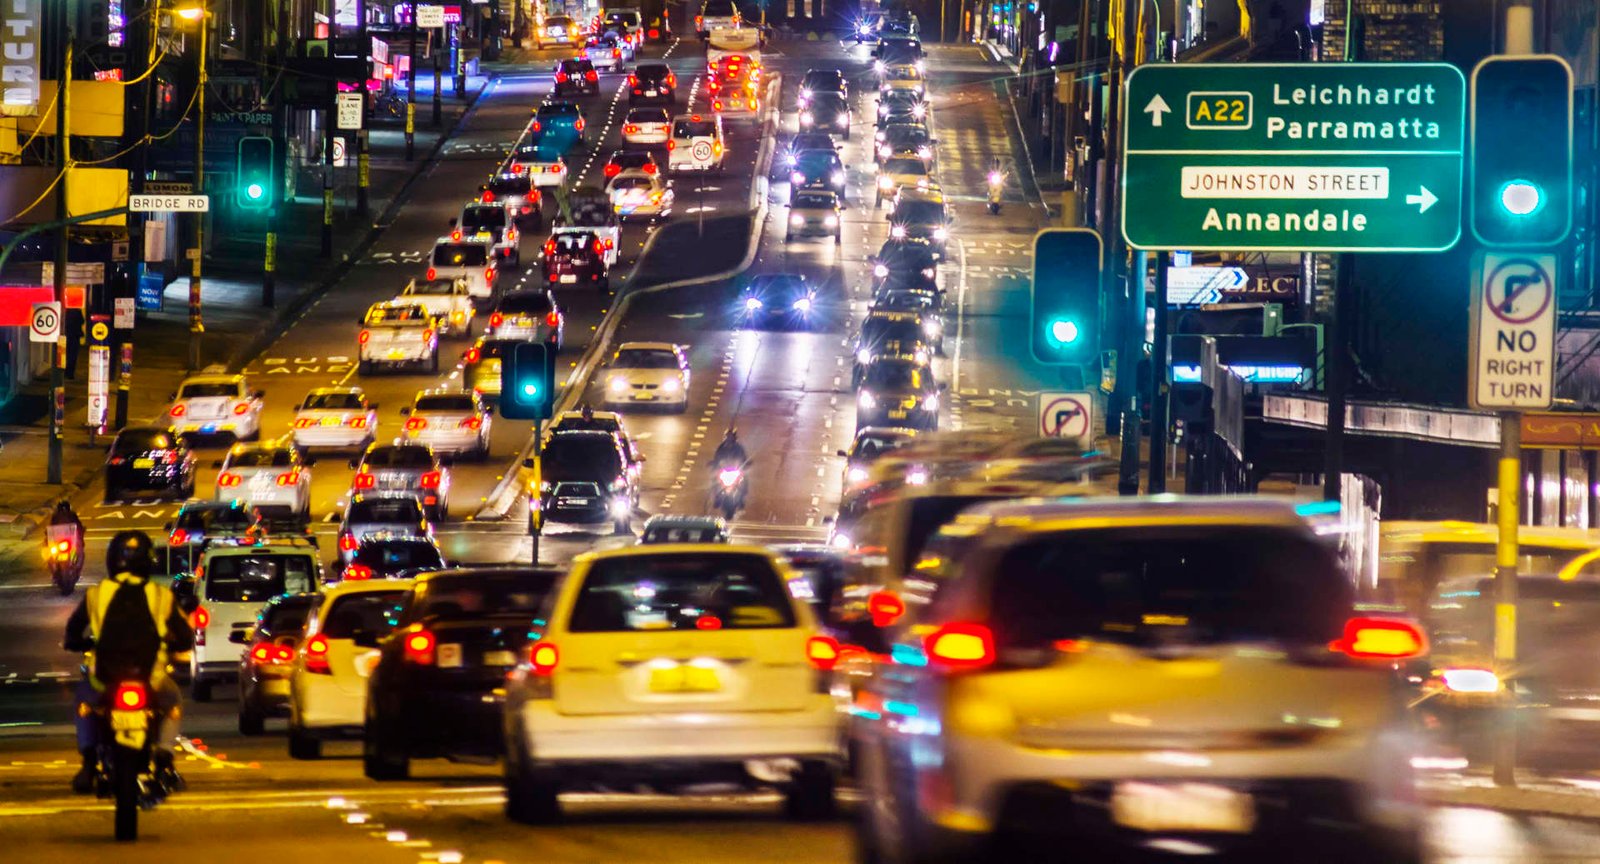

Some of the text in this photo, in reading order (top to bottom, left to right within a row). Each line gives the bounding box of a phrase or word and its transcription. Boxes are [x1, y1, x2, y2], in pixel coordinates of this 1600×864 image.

[1273, 83, 1436, 105] Leichhardt
[1196, 100, 1245, 121] A22
[1267, 117, 1440, 139] Parramatta
[696, 144, 710, 156] 60
[1189, 174, 1382, 191] JOHNSTON STREET
[133, 198, 205, 208] BRIDGE RD
[1202, 207, 1368, 232] Annandale
[142, 288, 159, 296] NOW
[36, 314, 54, 328] 60
[1496, 330, 1537, 353] NO
[1487, 360, 1545, 376] RIGHT
[1489, 382, 1543, 399] TURN
